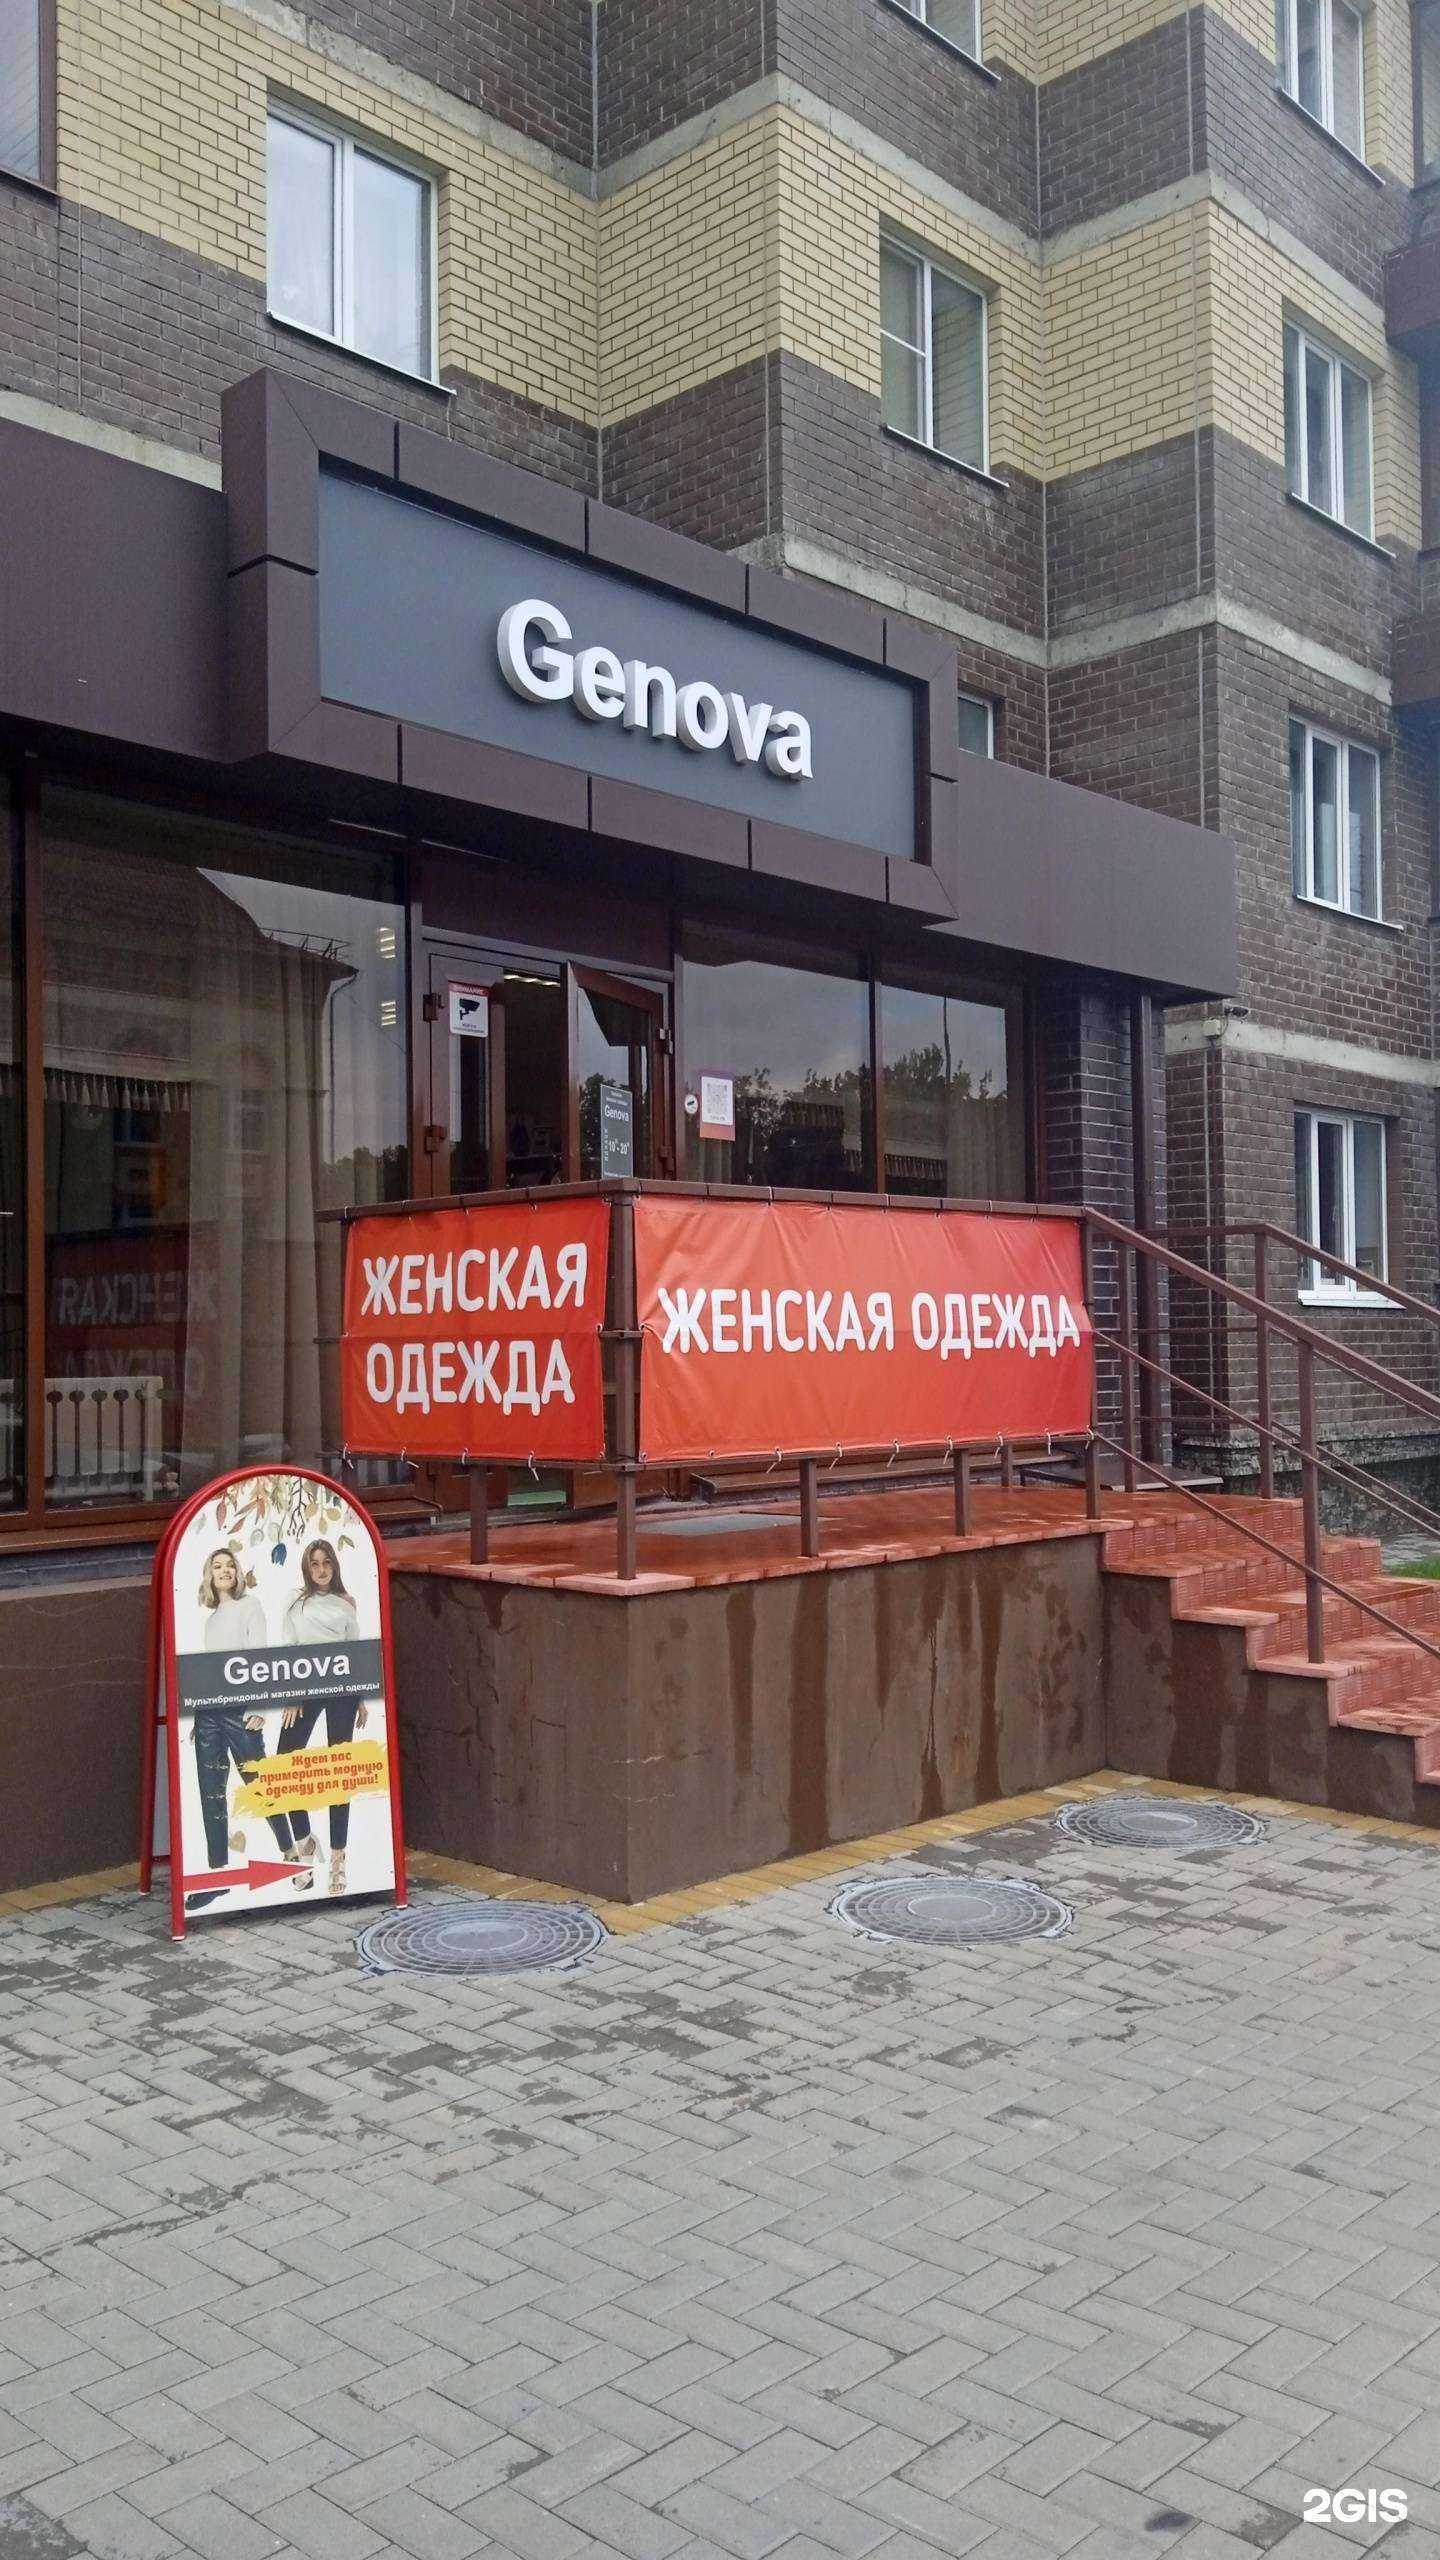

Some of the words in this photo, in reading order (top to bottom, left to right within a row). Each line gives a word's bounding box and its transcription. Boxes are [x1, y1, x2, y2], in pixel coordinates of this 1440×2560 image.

[496, 598, 814, 779] Genova
[604, 1104, 629, 1121] Genova
[361, 1243, 588, 1316] ЖЕНСКАЯ
[657, 1287, 895, 1354] ЖЕНСКАЯ
[911, 1292, 1081, 1361] ОДЕЖДА
[366, 1338, 576, 1416] ОДЕЖДА
[223, 1654, 351, 1685] Genova
[271, 1689, 306, 1699] магазин
[307, 1684, 344, 1696] женской
[345, 1682, 380, 1693] одежды
[260, 1768, 331, 1785] примерить
[333, 1762, 383, 1776] модную
[291, 1755, 328, 1769] Ждем
[331, 1752, 352, 1763] вас
[266, 1782, 314, 1798] одежду
[317, 1780, 339, 1793] для
[342, 1773, 378, 1790] души!
